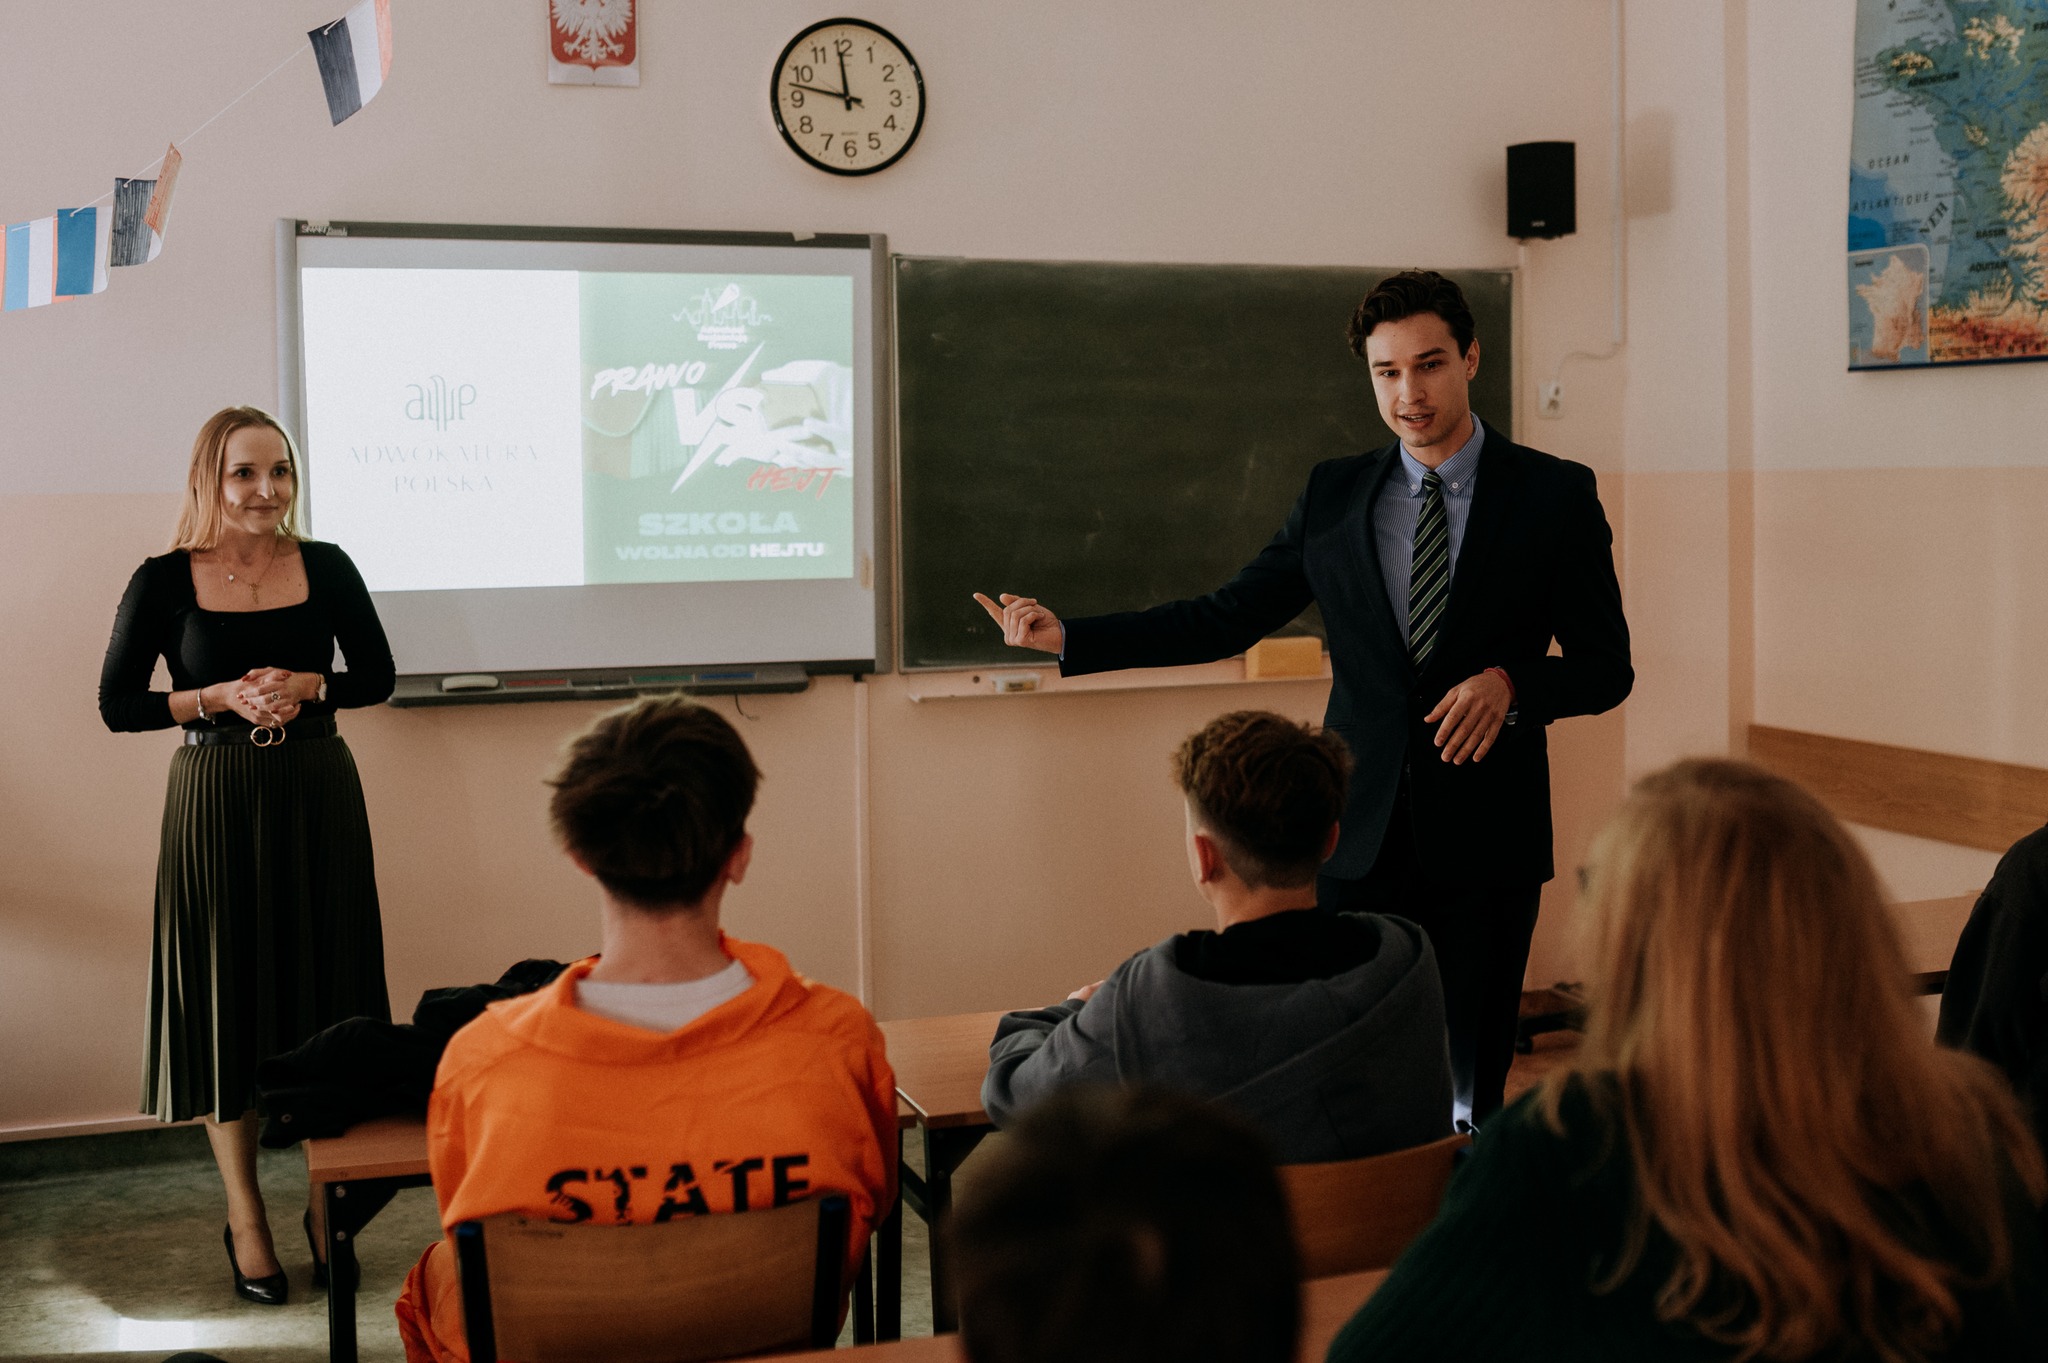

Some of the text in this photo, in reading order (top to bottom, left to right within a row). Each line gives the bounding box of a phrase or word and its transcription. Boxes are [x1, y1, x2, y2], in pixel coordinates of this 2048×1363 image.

[811, 46, 827, 64] 11
[833, 38, 853, 57] 12
[866, 46, 873, 64] 1
[792, 65, 814, 83] 10
[882, 64, 895, 82] 2
[790, 90, 804, 108] 9
[889, 89, 902, 107] 3
[800, 115, 814, 134] 8
[883, 114, 897, 132] 4
[820, 133, 834, 151] 7
[843, 140, 857, 158] 6
[868, 132, 881, 150] 5
[590, 360, 707, 400] PRAWO
[394, 475, 494, 494] POLSKA
[746, 464, 845, 500] HEJT
[638, 510, 801, 536] SZKOŁA
[616, 542, 826, 560] WOLNA OD HEJTU
